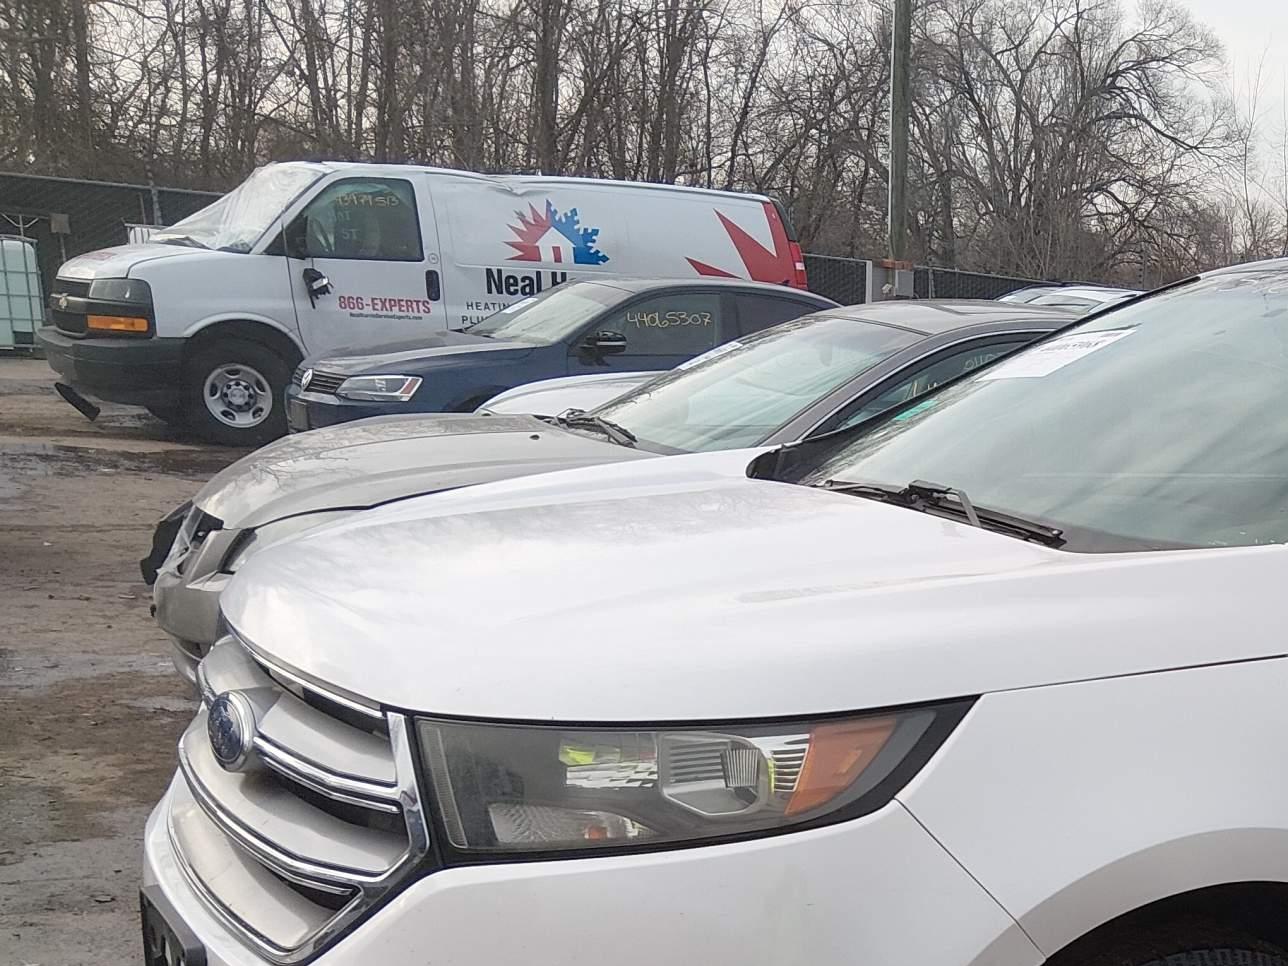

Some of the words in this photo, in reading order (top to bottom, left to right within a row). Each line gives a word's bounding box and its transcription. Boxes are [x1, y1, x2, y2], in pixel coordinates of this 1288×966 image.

[485, 267, 542, 297] Neal
[551, 271, 567, 287] H
[338, 295, 431, 314] 866-EXPERTS
[466, 301, 511, 311] HEATIN
[627, 311, 712, 329] 44065307
